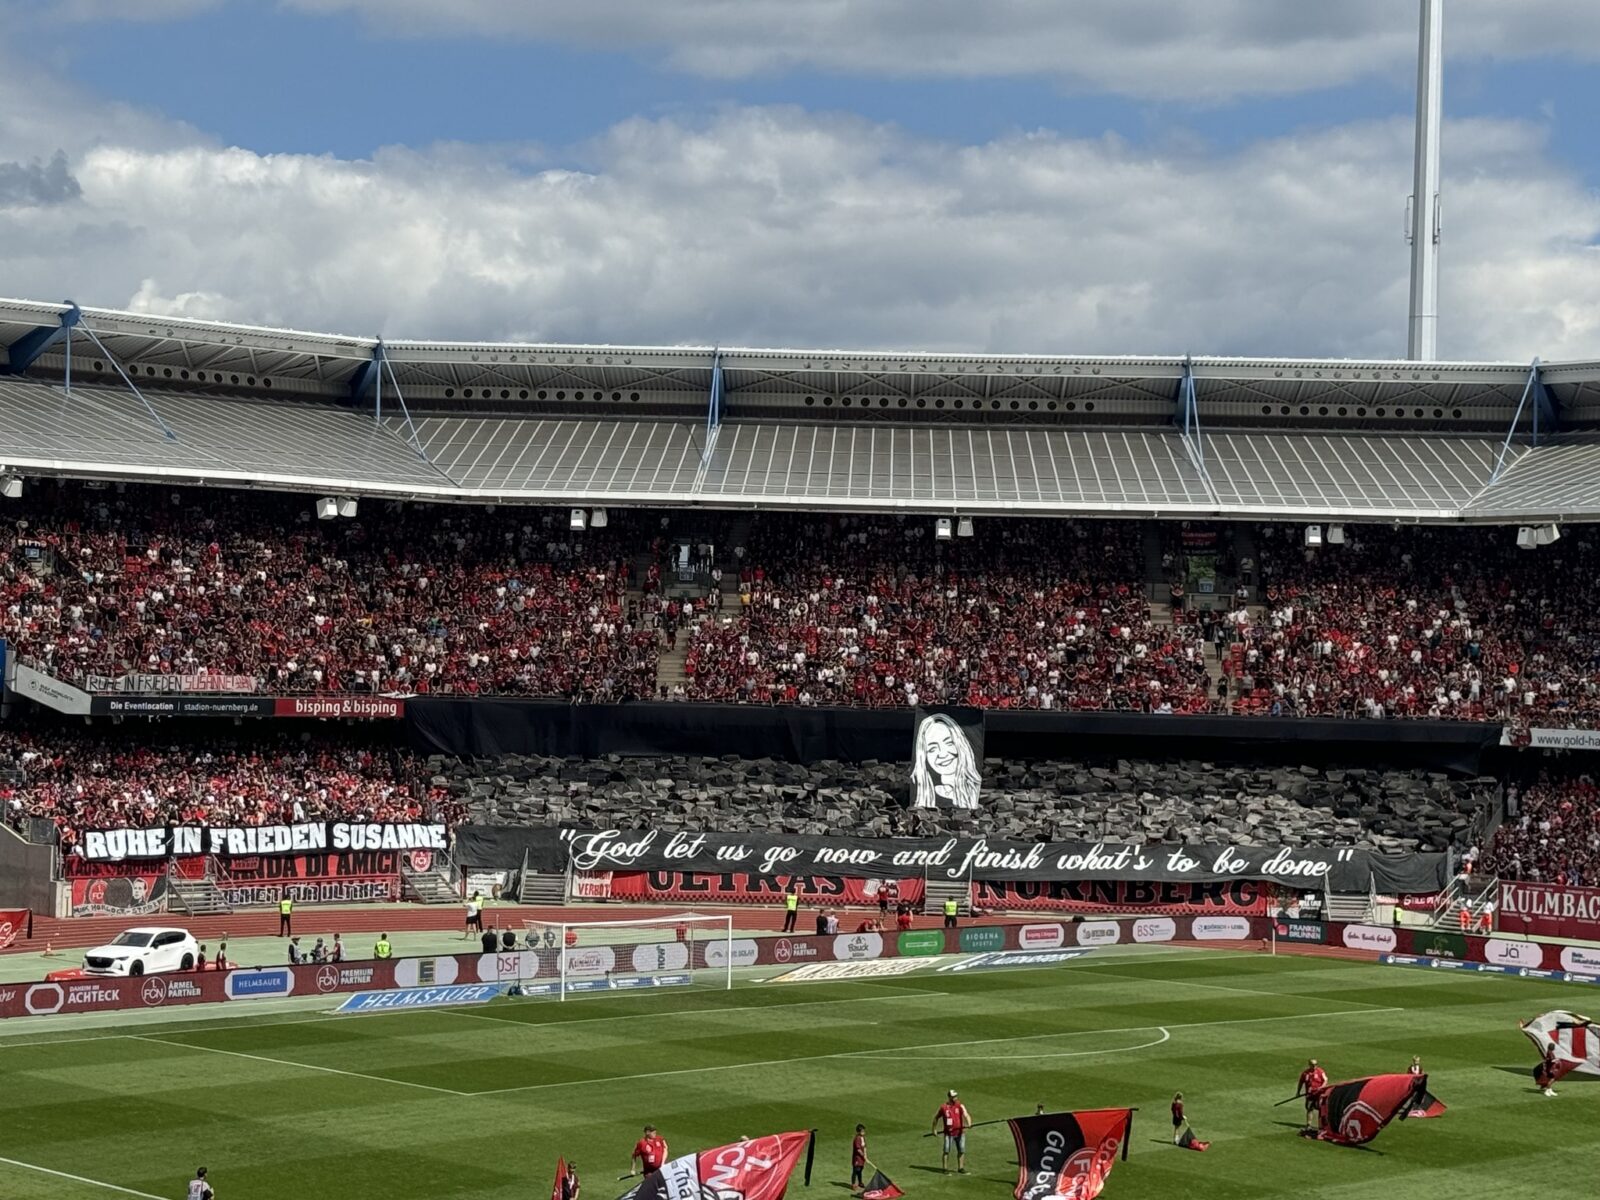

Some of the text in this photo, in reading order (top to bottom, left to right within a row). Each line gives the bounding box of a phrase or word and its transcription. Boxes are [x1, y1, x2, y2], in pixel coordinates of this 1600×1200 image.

[125, 675, 136, 690] IN
[138, 675, 183, 690] FRIEDEN
[110, 701, 174, 710] Die Eventlocation
[184, 702, 259, 714] stadion-nuernberg.de
[296, 699, 397, 716] bisping & bisping
[85, 822, 447, 860] RUHE IN FRIEDEN SUSANNE
[663, 831, 707, 859] let
[716, 844, 753, 861] us
[758, 845, 804, 874] go
[813, 847, 883, 864] now
[892, 838, 958, 866] and
[946, 839, 1046, 878] finish
[1056, 842, 1154, 872] what's
[1166, 847, 1200, 873] to
[1212, 846, 1250, 874] be
[336, 852, 399, 876] AMICI
[646, 869, 845, 896] ULTRAS
[1137, 925, 1155, 937] BSS
[1289, 923, 1322, 933] FRANKEN
[966, 933, 999, 941] BIOGENA
[1288, 930, 1321, 940] BRUNNEN
[340, 968, 374, 978] PREMIUM
[168, 980, 194, 990] ÄRMEL
[238, 978, 281, 989] HELMSAUER
[318, 976, 337, 987] FCN
[340, 976, 372, 985] PARTNER
[67, 989, 120, 1004] ACHTECK
[143, 988, 164, 1000] FCN
[168, 988, 201, 998] PARTNER
[358, 986, 489, 1009] HELMSAUER
